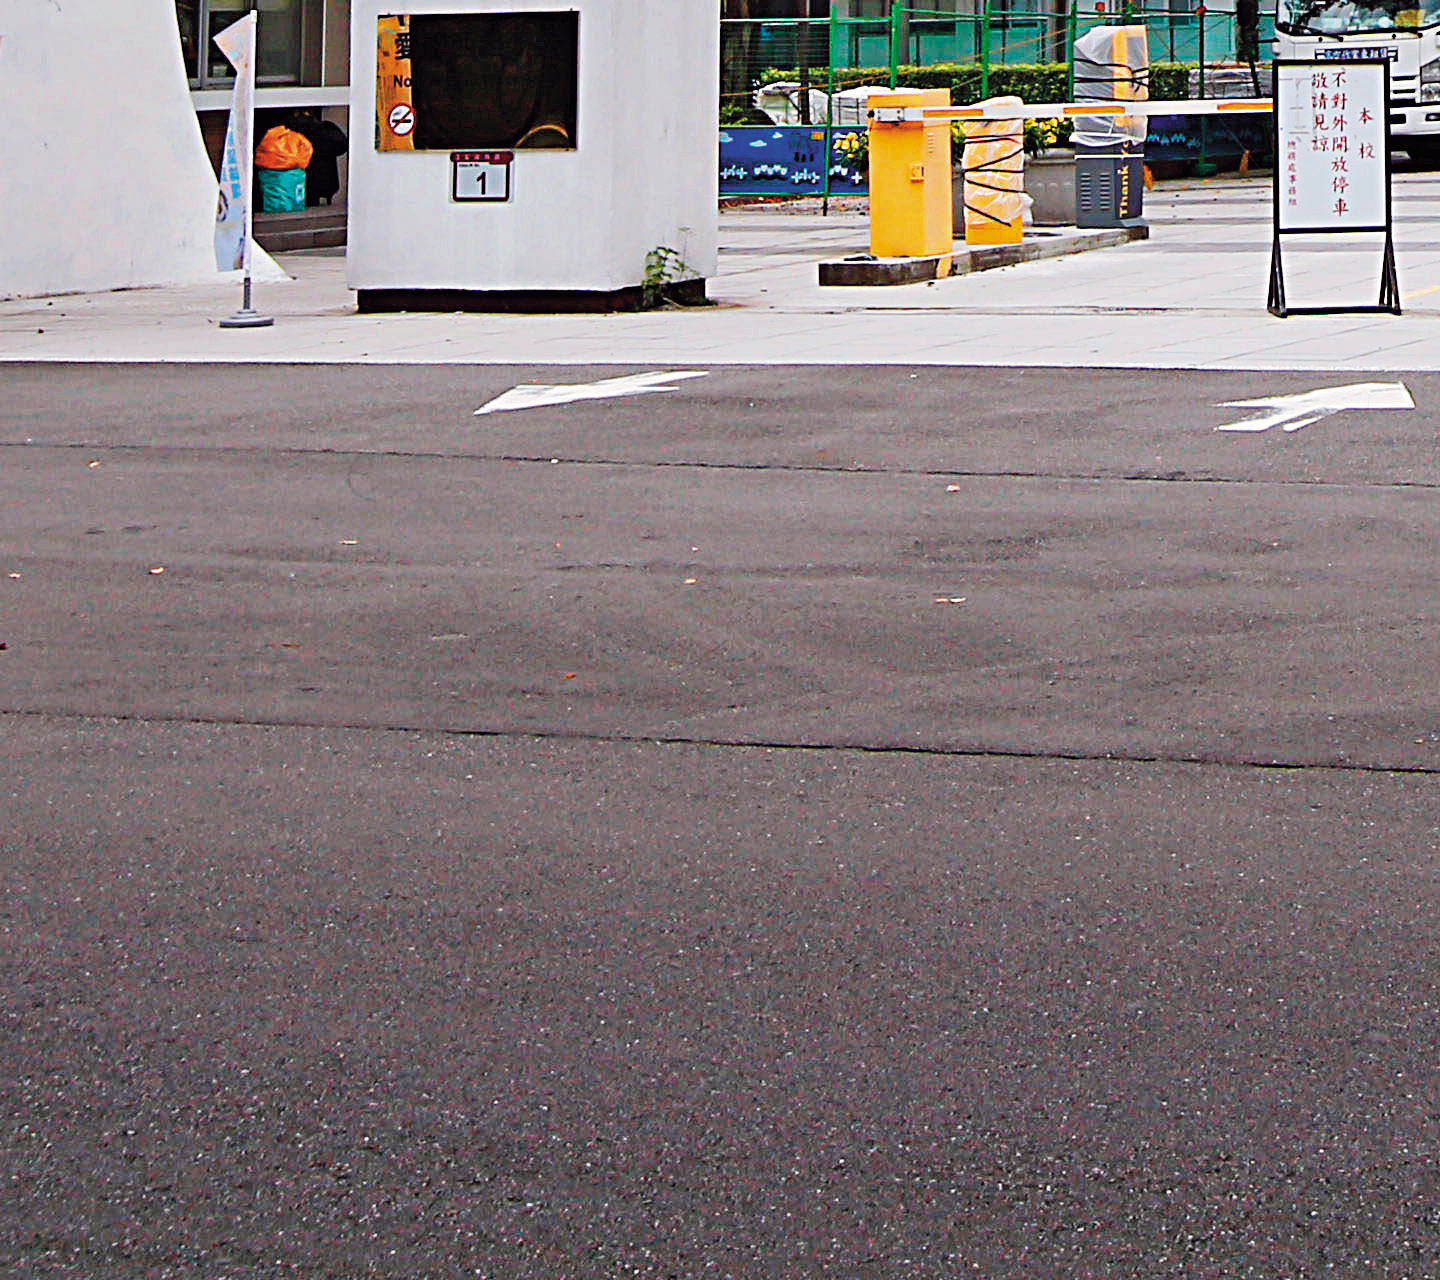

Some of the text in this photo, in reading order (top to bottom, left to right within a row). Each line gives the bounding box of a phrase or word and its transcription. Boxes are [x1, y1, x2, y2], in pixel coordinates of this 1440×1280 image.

[1311, 73, 1329, 152] 敬請見諒
[1359, 108, 1376, 159] 本校
[1331, 71, 1349, 216] 不對外開放停車
[476, 171, 486, 195] 1
[1118, 166, 1128, 217] Thank
